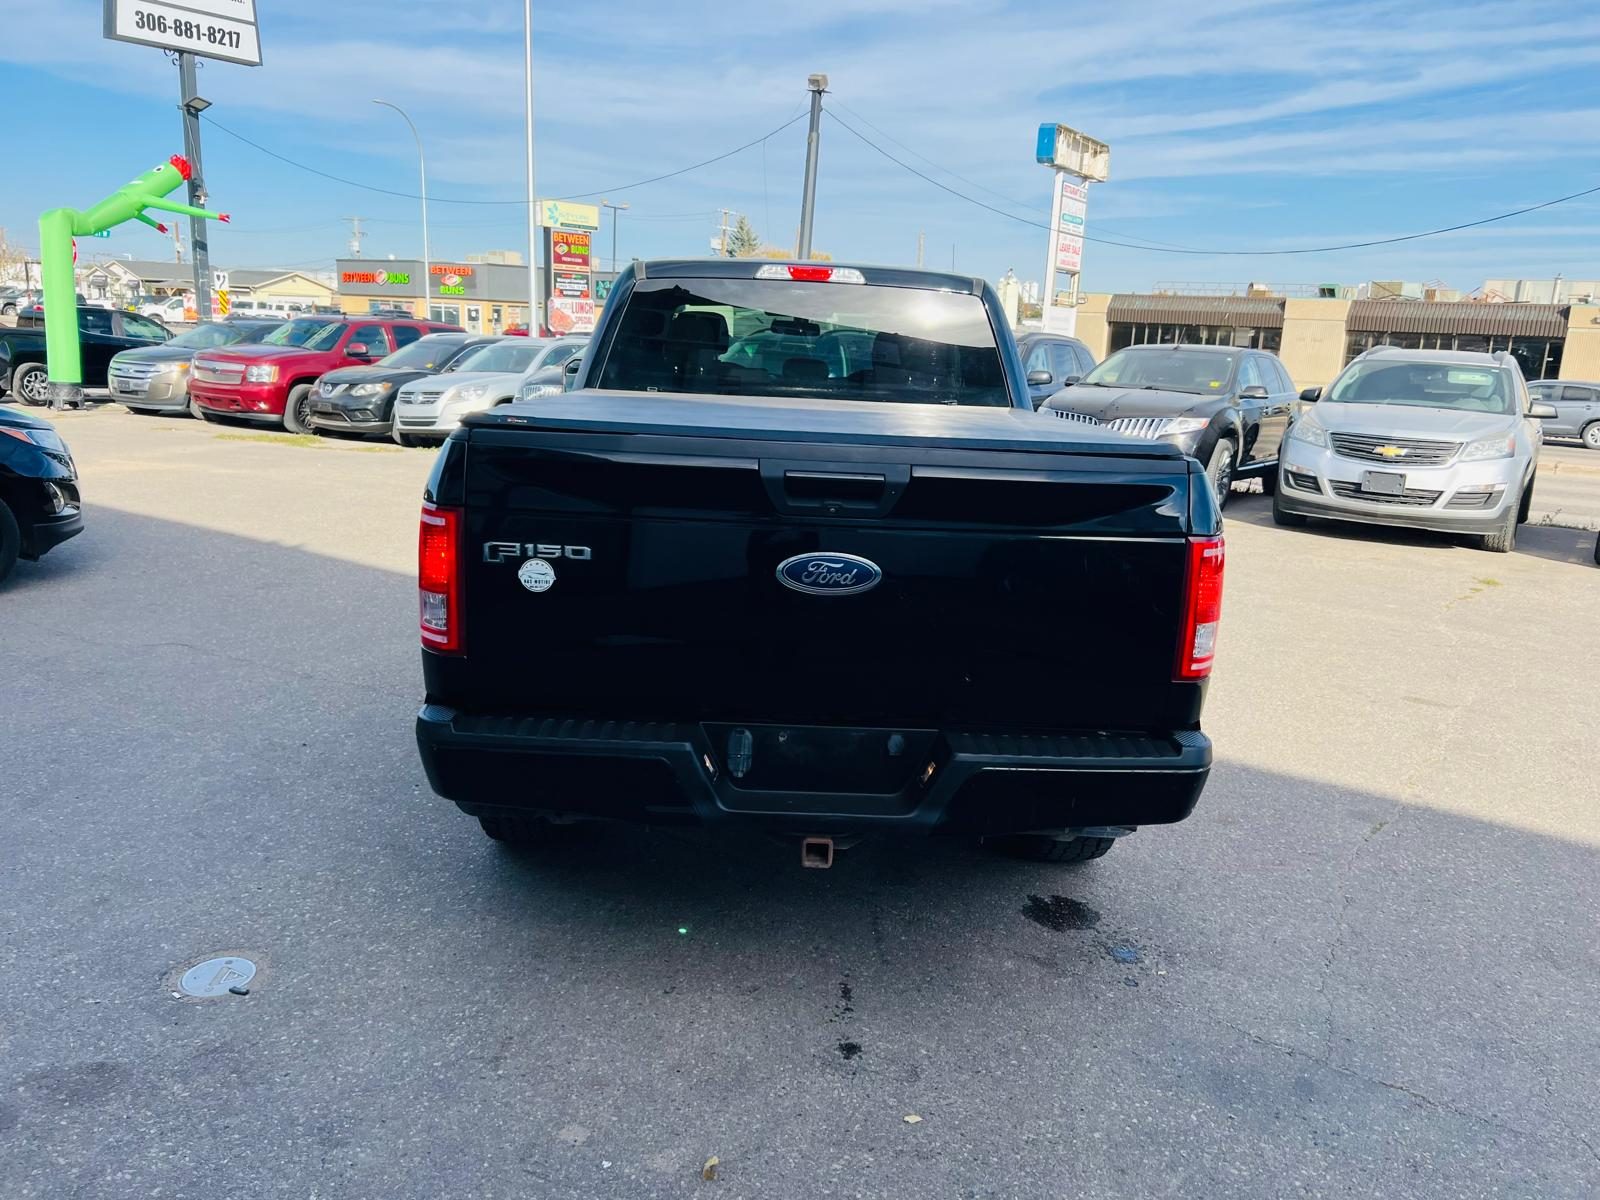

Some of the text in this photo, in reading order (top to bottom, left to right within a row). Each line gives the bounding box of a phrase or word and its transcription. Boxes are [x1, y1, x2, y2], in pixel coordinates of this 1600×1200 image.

[134, 10, 241, 49] 306-881-8217
[553, 231, 589, 245] BETWEEN
[570, 244, 589, 255] BUNS
[430, 265, 472, 276] BETWEEN
[342, 271, 410, 285] BETWEEN BUNS
[440, 286, 465, 295] BUNS
[571, 301, 594, 314] LUNCH
[801, 560, 858, 585] Ford
